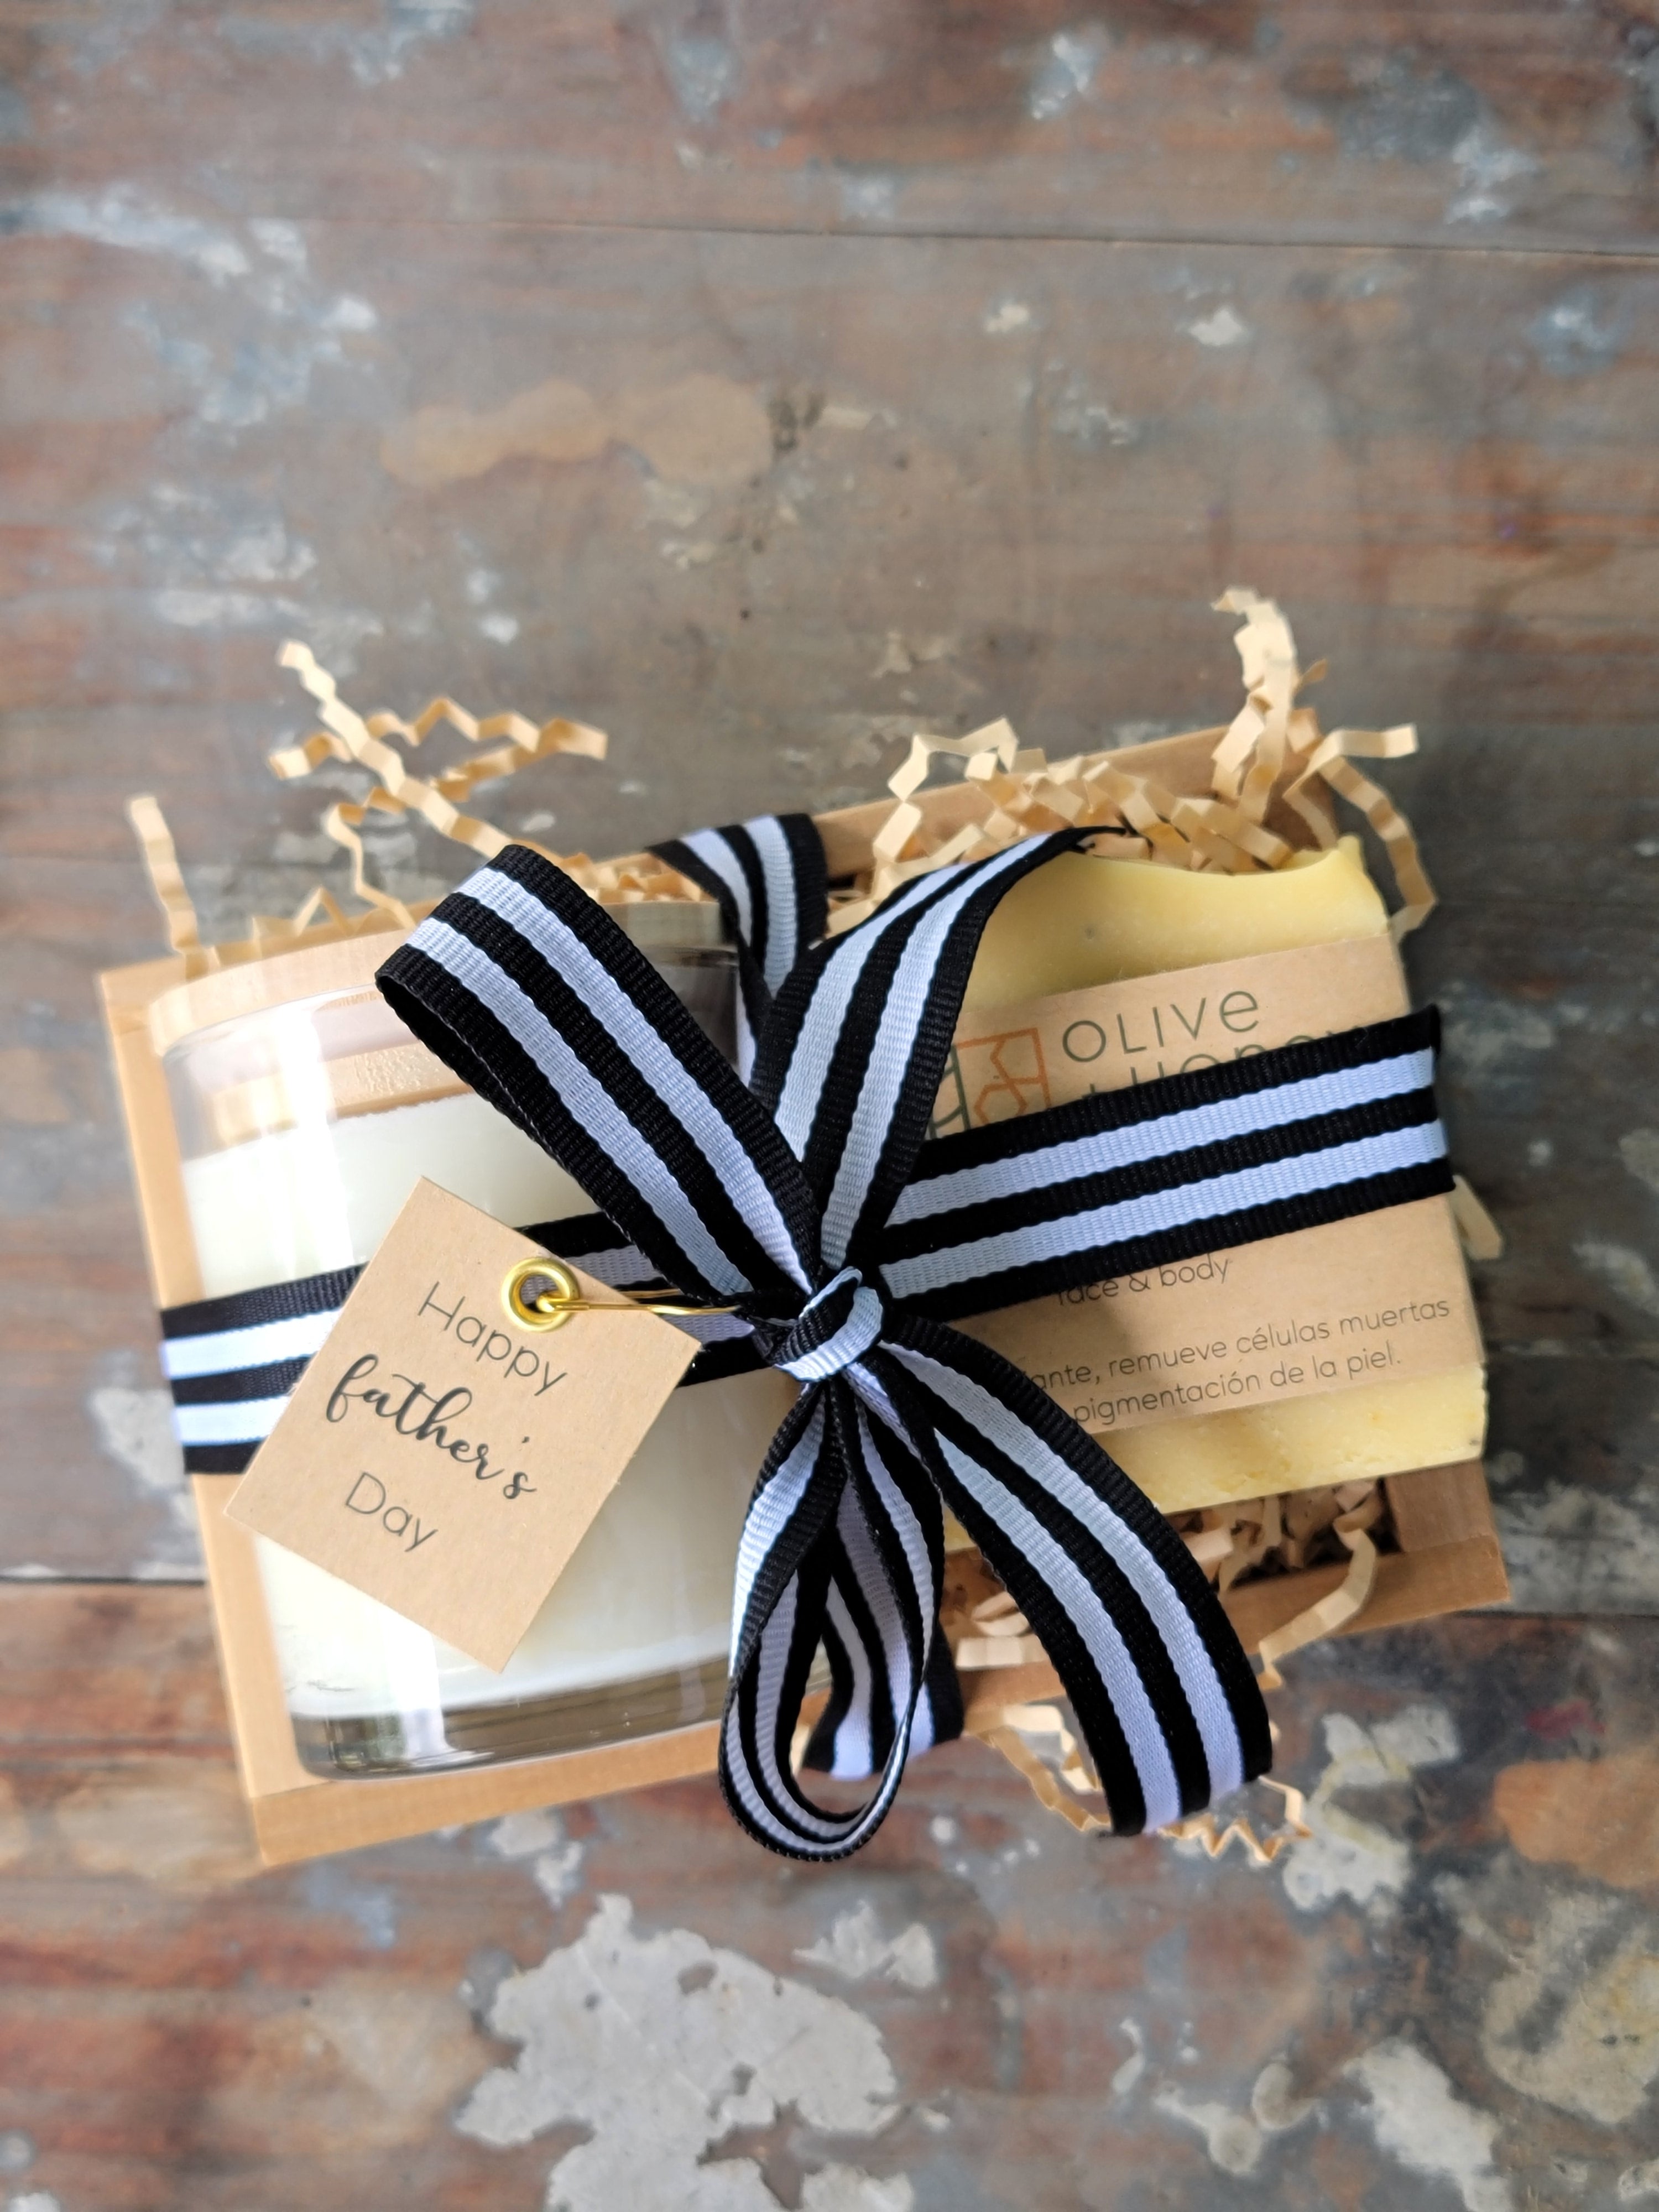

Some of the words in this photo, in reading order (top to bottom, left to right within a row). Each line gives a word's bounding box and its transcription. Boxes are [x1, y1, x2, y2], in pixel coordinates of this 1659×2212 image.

[1129, 1275, 1151, 1292] &
[1158, 1253, 1228, 1285] body
[418, 1281, 568, 1396] Happy
[1108, 1341, 1227, 1378] remueve
[1236, 1319, 1331, 1354] células
[1339, 1299, 1450, 1335] muertas
[1073, 1371, 1261, 1426] pigmentación
[1270, 1360, 1304, 1387] de
[1311, 1355, 1337, 1379] la
[1347, 1339, 1401, 1380] piel.
[326, 1353, 538, 1500] father's
[345, 1471, 439, 1553] Day
